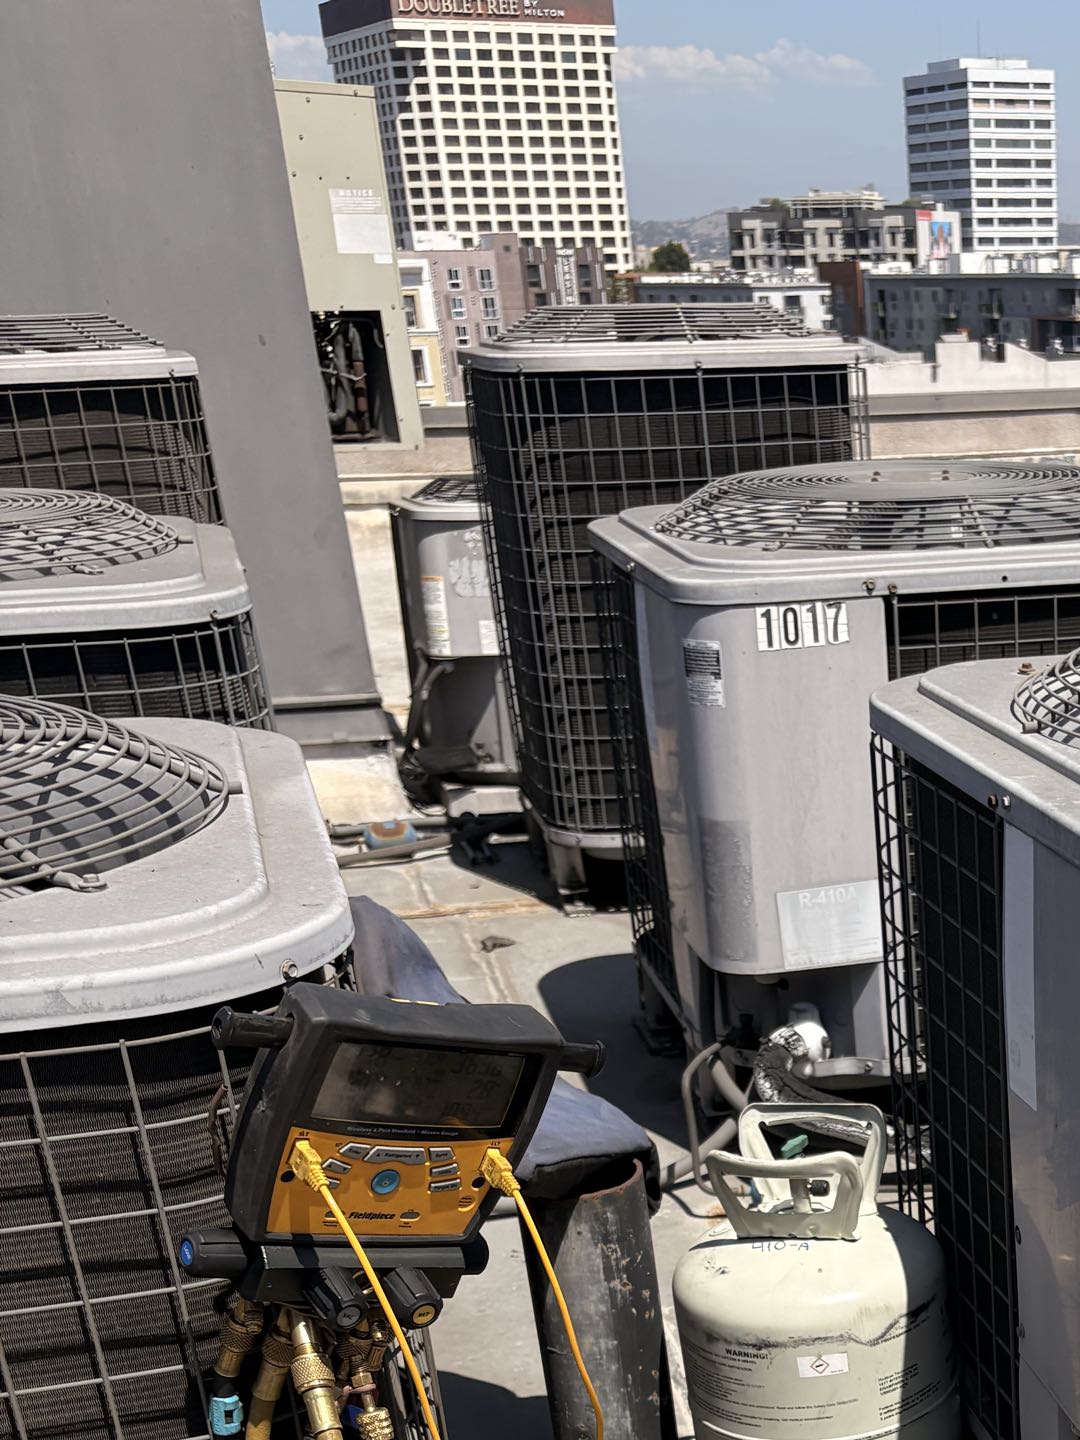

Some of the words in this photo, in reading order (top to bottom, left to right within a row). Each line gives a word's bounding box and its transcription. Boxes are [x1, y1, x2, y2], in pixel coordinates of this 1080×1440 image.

[398, 0, 521, 16] DOUBLETREE
[523, 0, 538, 8] BY
[524, 8, 565, 17] HILTON
[761, 602, 842, 649] 1017
[348, 1210, 397, 1221] Fieldpiece
[752, 1241, 810, 1253] 410-A
[725, 1347, 769, 1360] WARNING!
